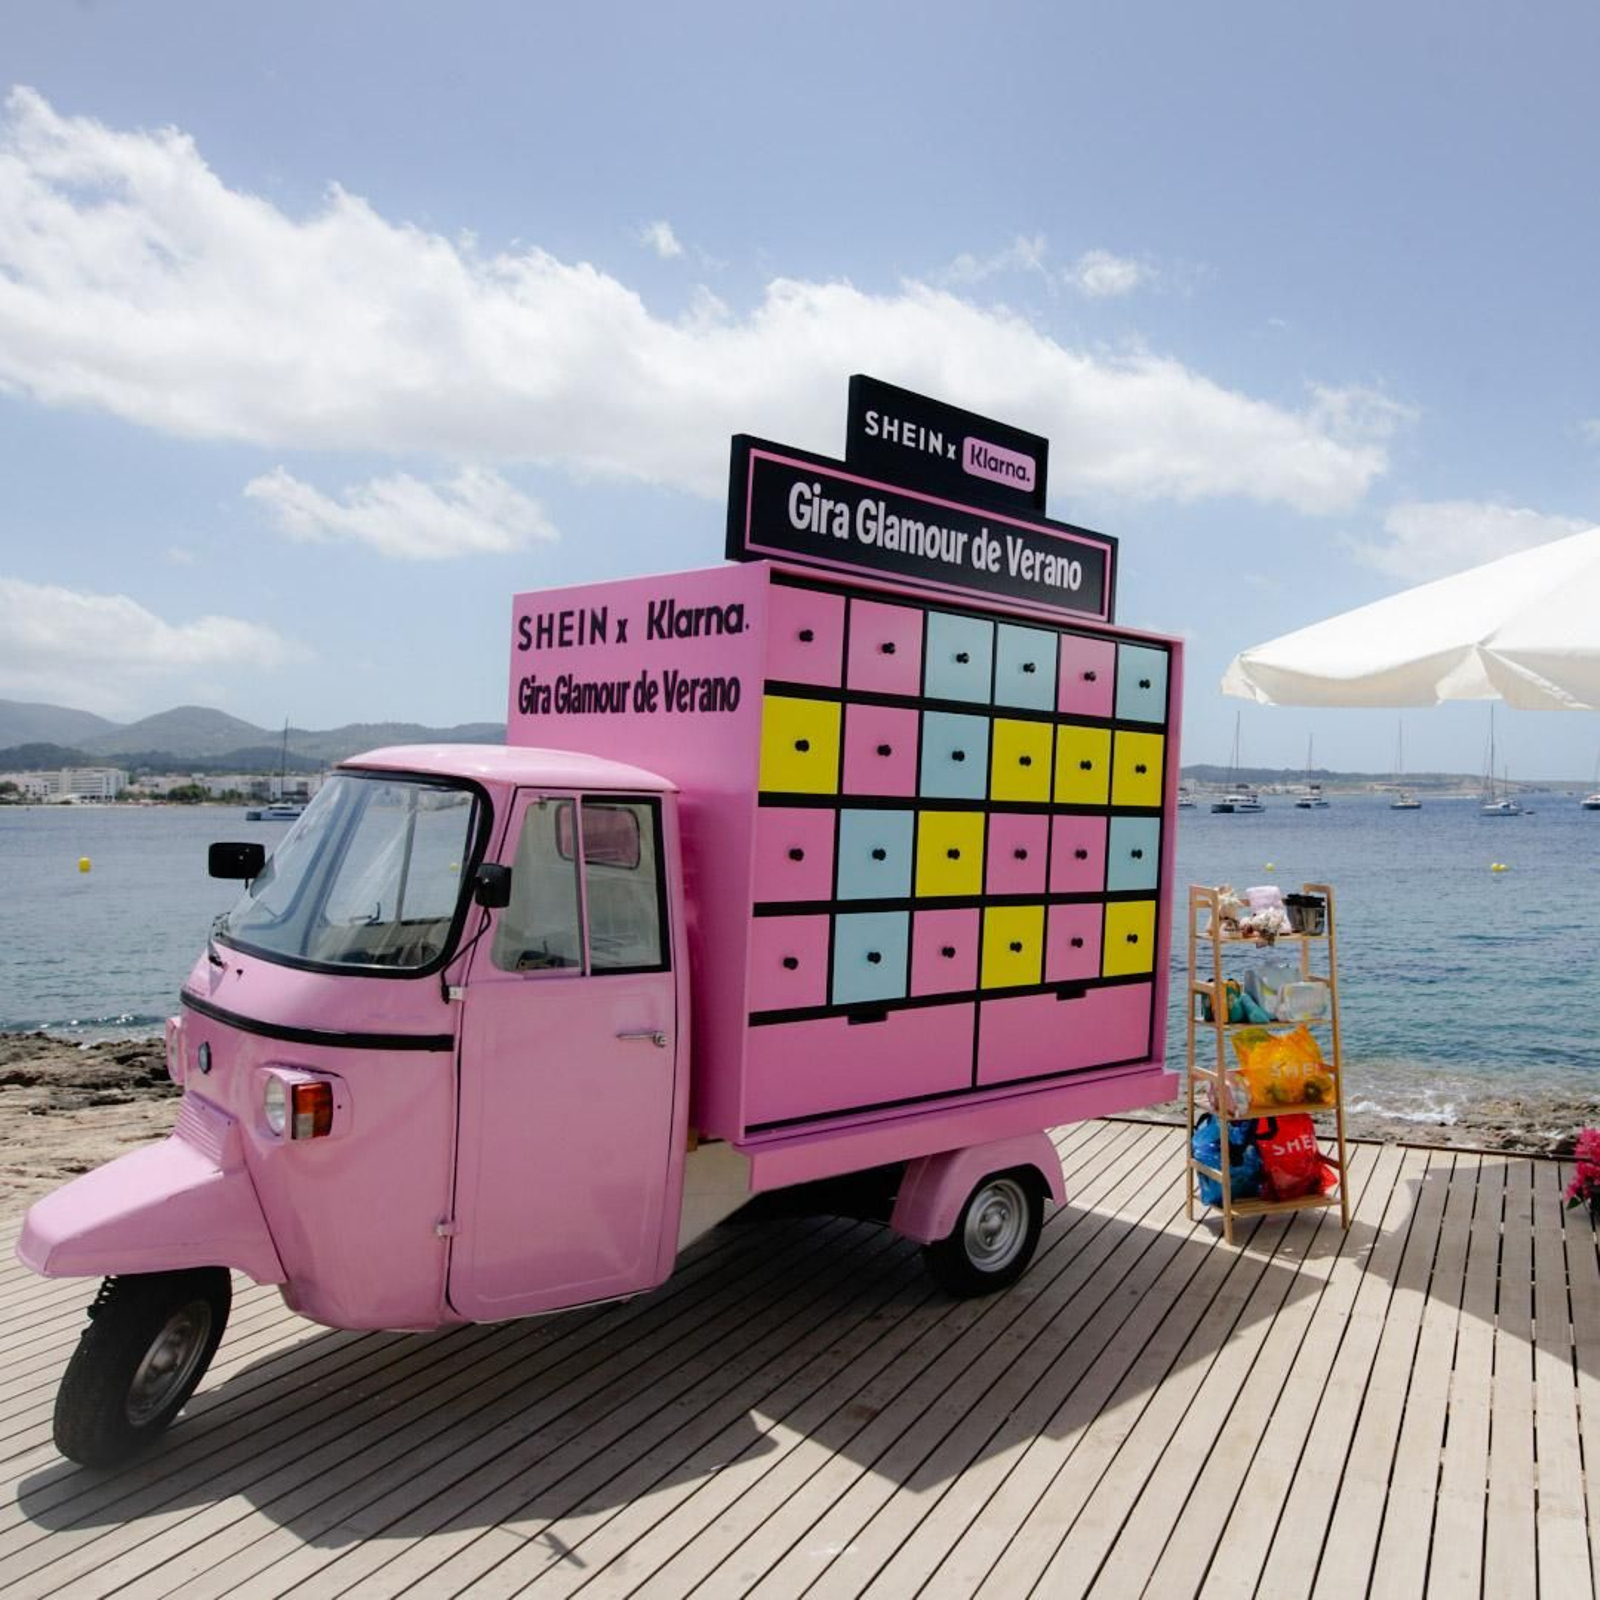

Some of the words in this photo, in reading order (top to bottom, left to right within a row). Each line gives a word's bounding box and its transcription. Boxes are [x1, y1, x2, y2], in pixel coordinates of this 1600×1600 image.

[864, 410, 943, 456] SHEIN
[970, 444, 1031, 483] Klarna.
[788, 482, 849, 540] Gira
[855, 498, 968, 565] Glamour
[971, 527, 1001, 573] de
[1006, 535, 1082, 592] Verano
[517, 606, 608, 651] SHEIN
[646, 598, 749, 641] Klarna.
[518, 674, 552, 715] Gira
[554, 673, 631, 714] Glamour
[633, 669, 658, 714] de
[662, 669, 741, 714] Verano
